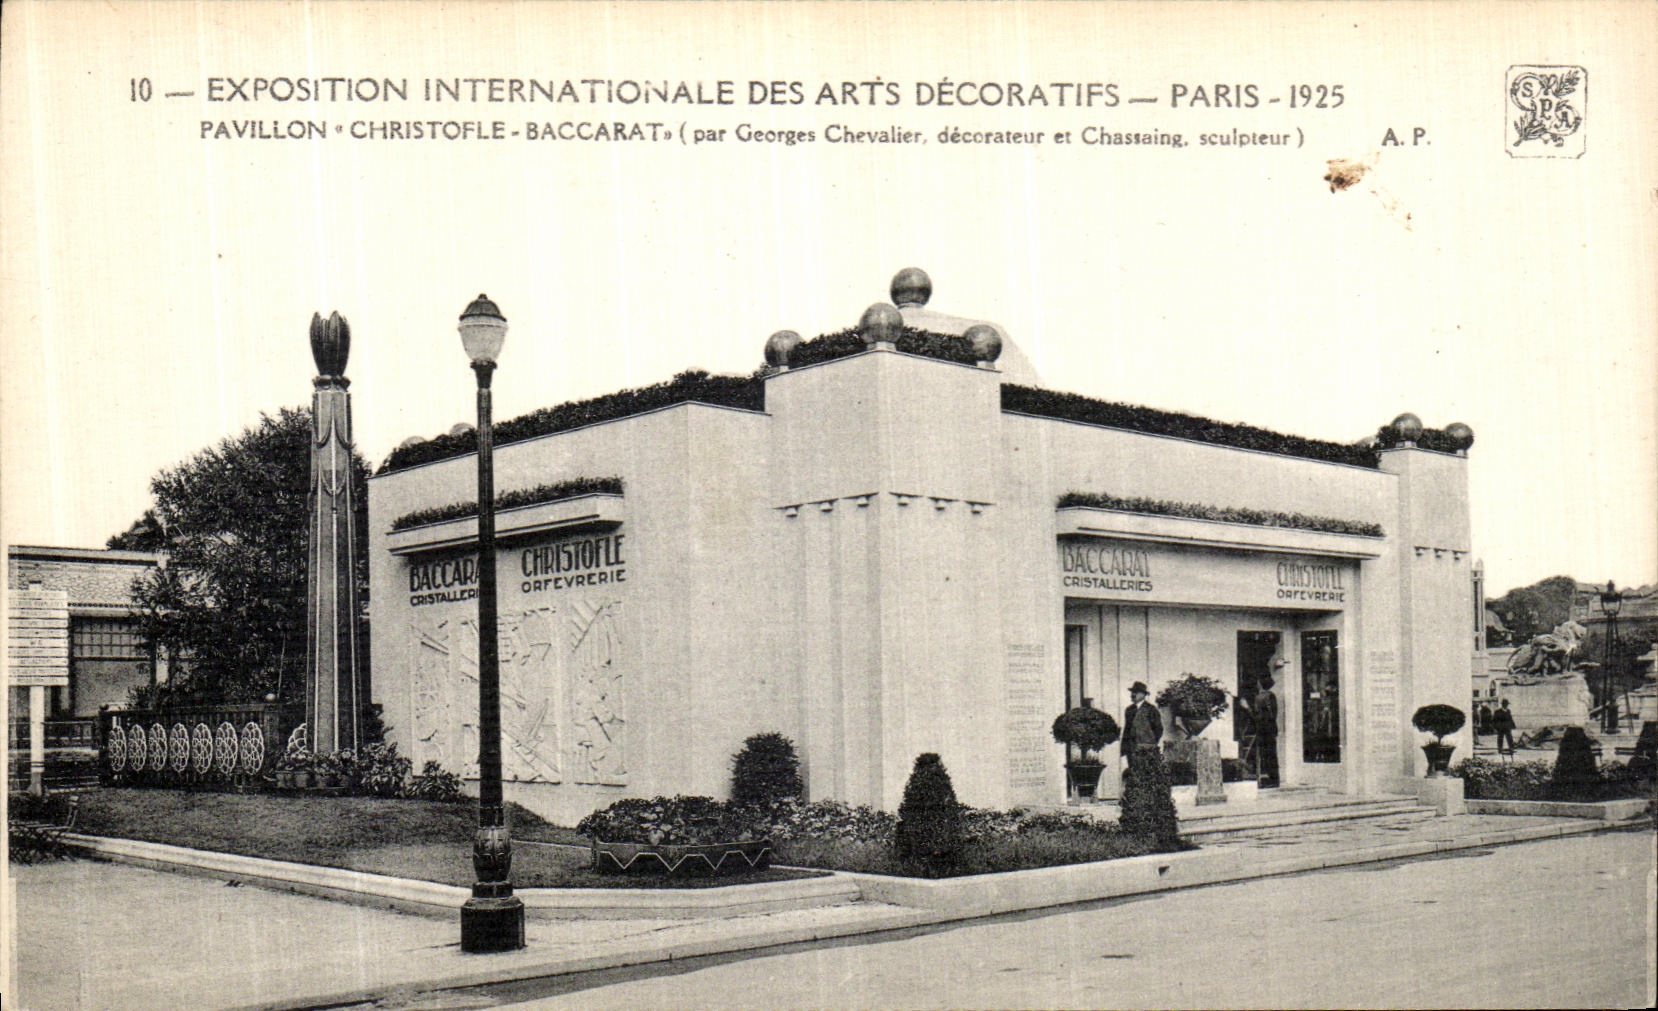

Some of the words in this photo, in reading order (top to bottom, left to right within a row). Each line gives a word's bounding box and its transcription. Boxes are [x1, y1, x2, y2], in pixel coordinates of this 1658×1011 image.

[521, 535, 625, 577] CHRISTOFLE
[1063, 544, 1150, 578] BACCARAT
[521, 569, 626, 593] ORFEVRERIE
[1063, 576, 1153, 592] CRISTALLERIES
[1277, 588, 1344, 602] ORFEVRERIE
